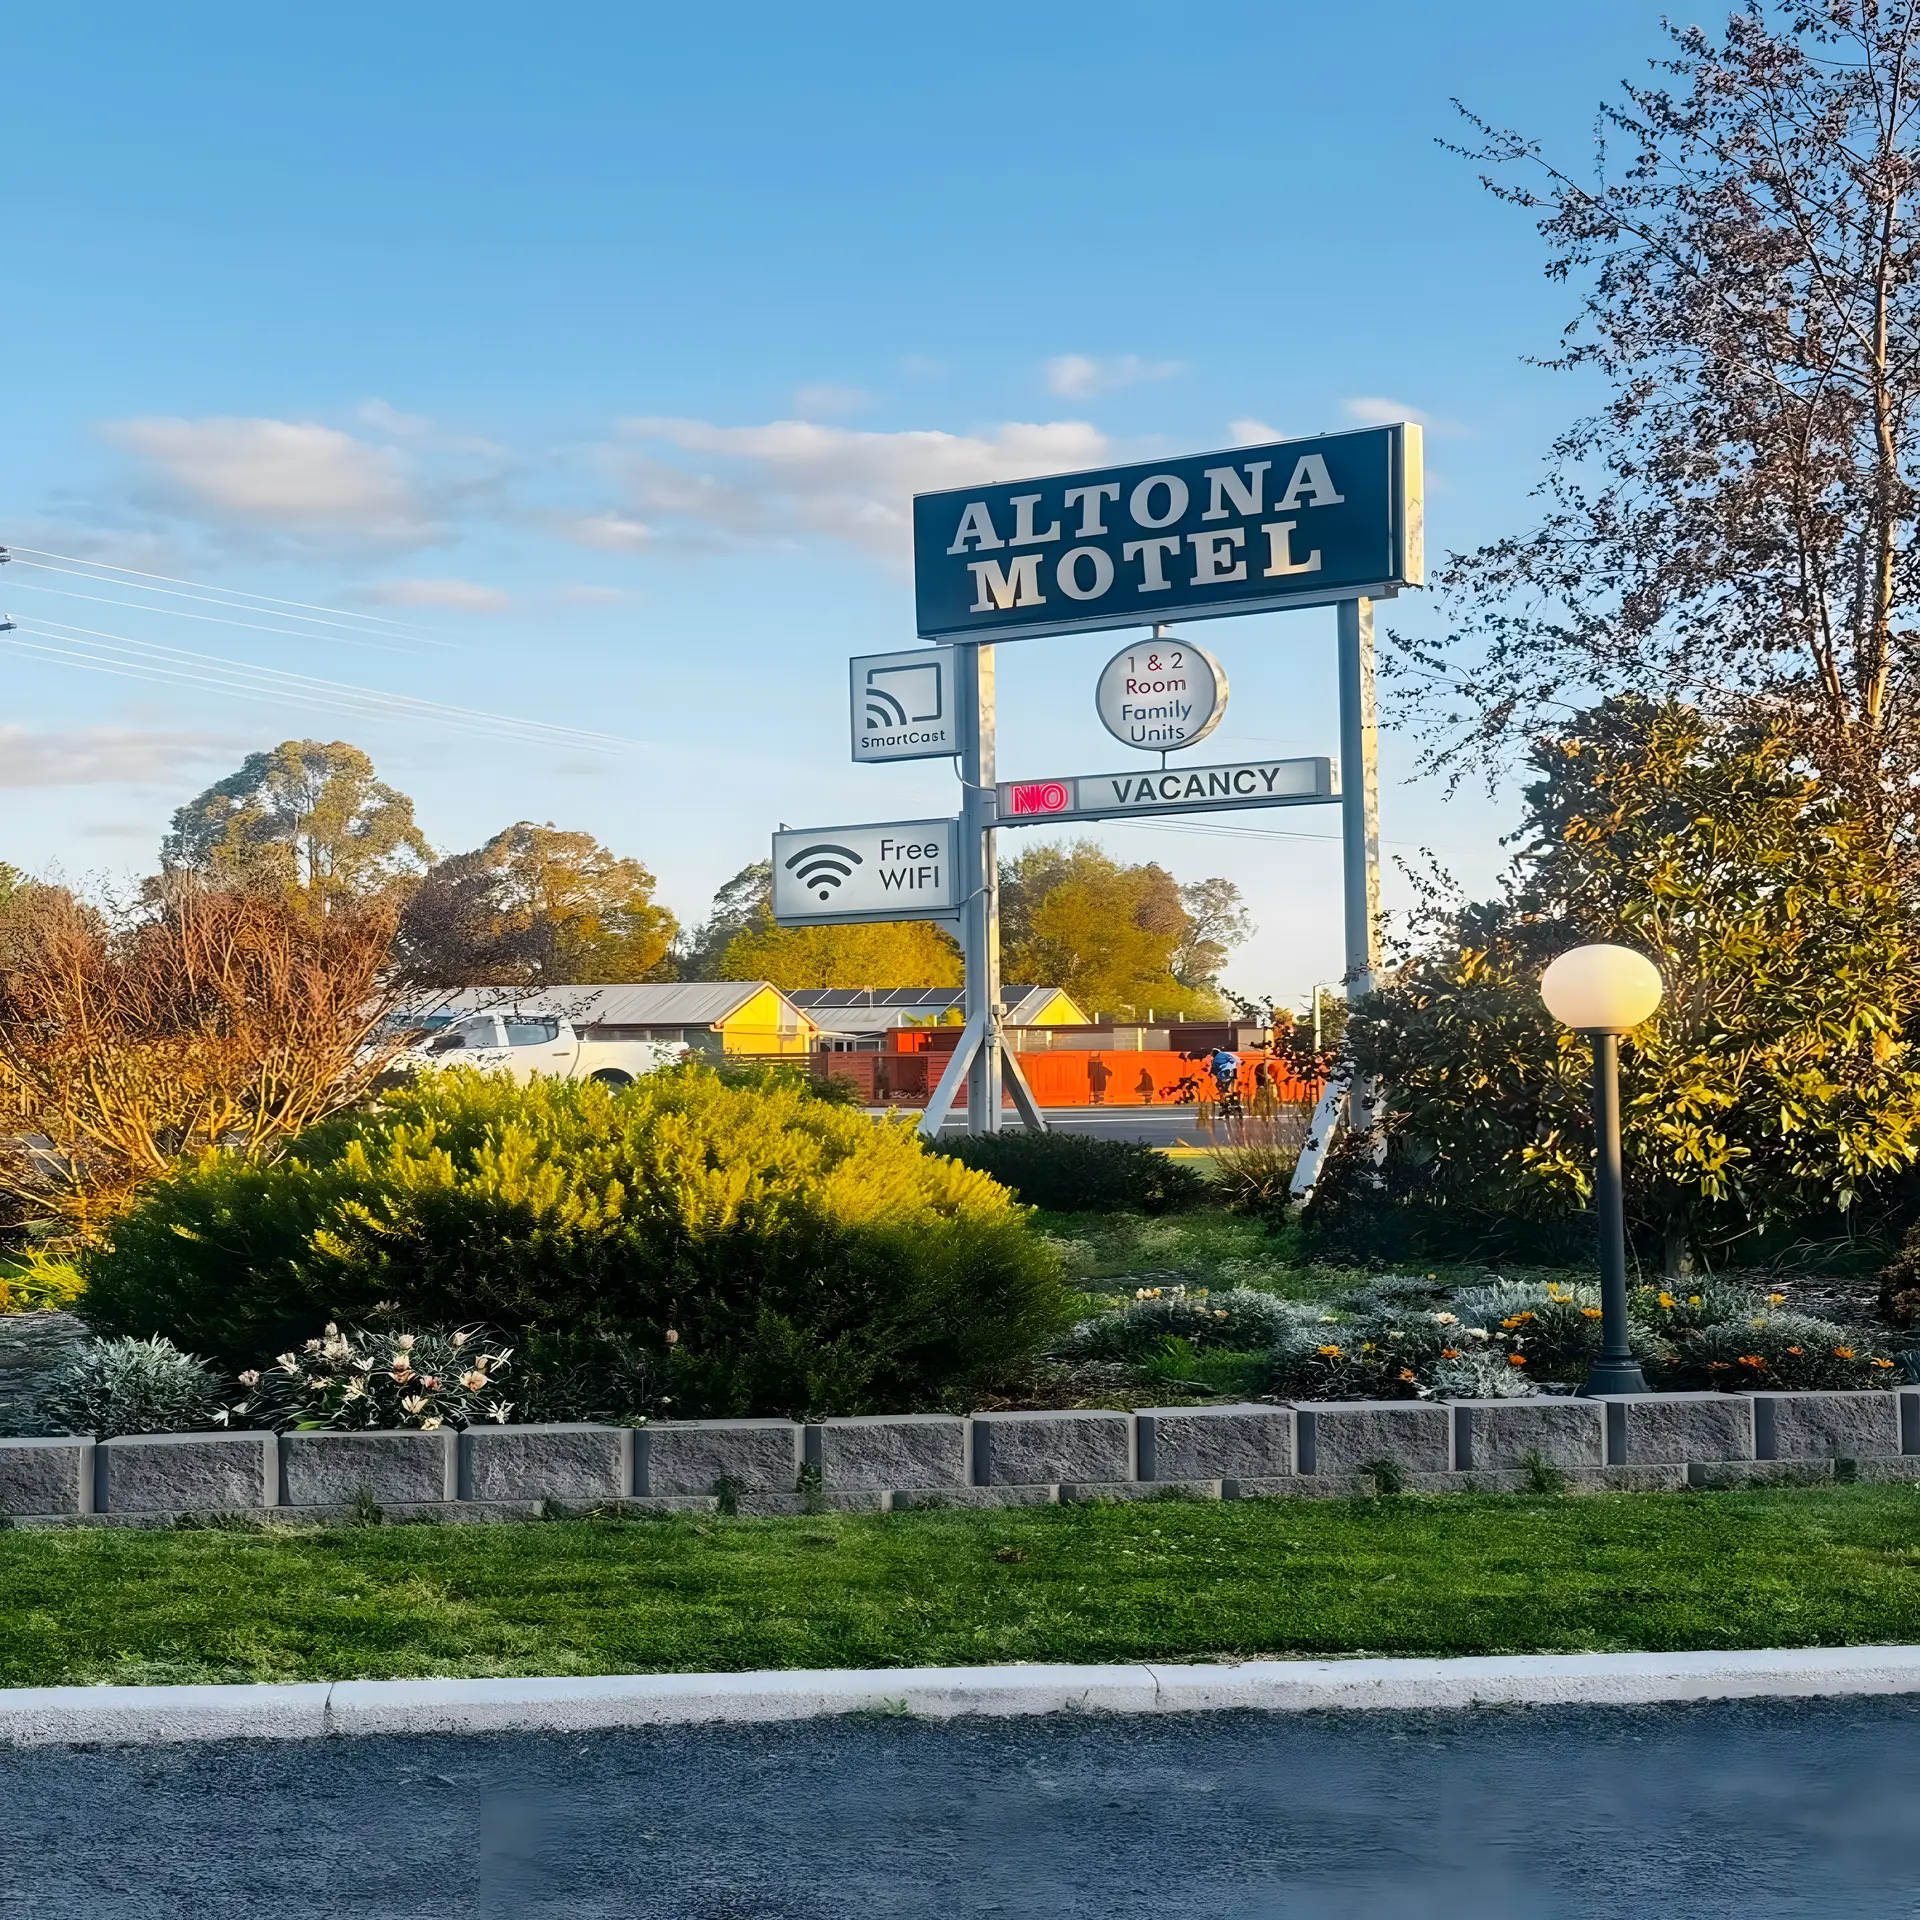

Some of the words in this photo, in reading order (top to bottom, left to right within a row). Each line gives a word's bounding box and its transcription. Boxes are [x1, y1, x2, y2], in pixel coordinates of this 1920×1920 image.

[946, 453, 1345, 555] ALTONA
[967, 520, 1322, 613] MOTEL
[1127, 656, 1135, 673] 1
[1147, 654, 1163, 671] &
[1170, 652, 1183, 669] 2
[1126, 678, 1186, 695] Room
[1122, 699, 1192, 721] Family
[861, 730, 946, 748] SmartCast
[1131, 723, 1185, 742] Units
[1011, 782, 1068, 814] NO
[1112, 768, 1281, 803] VACANCY
[881, 839, 939, 861] Free
